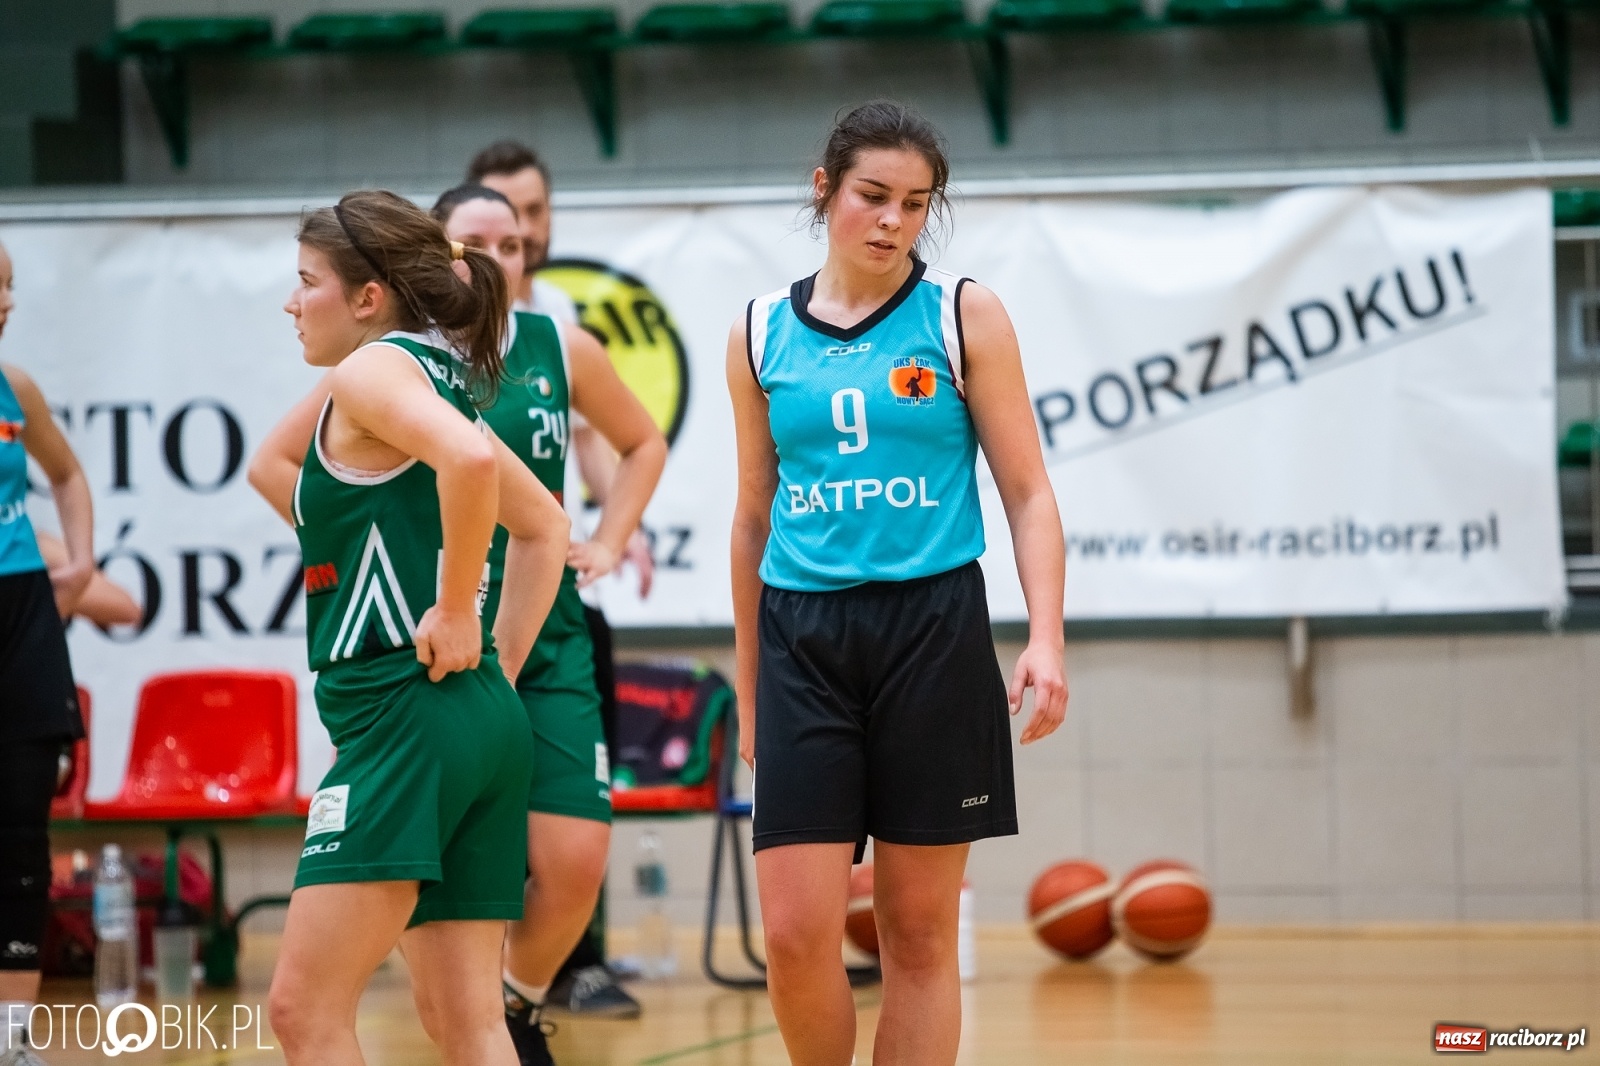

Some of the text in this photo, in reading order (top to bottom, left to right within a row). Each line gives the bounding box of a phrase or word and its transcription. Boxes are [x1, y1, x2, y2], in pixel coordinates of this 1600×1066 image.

[825, 342, 871, 357] COLO
[1034, 248, 1477, 449] PORZĄDKU!
[893, 357, 911, 369] UKS
[896, 396, 916, 406] NOWY
[831, 387, 869, 455] 9
[528, 407, 567, 461] 24
[787, 476, 940, 514] BATPOL
[962, 794, 989, 808] COLO
[301, 841, 341, 858] COLO
